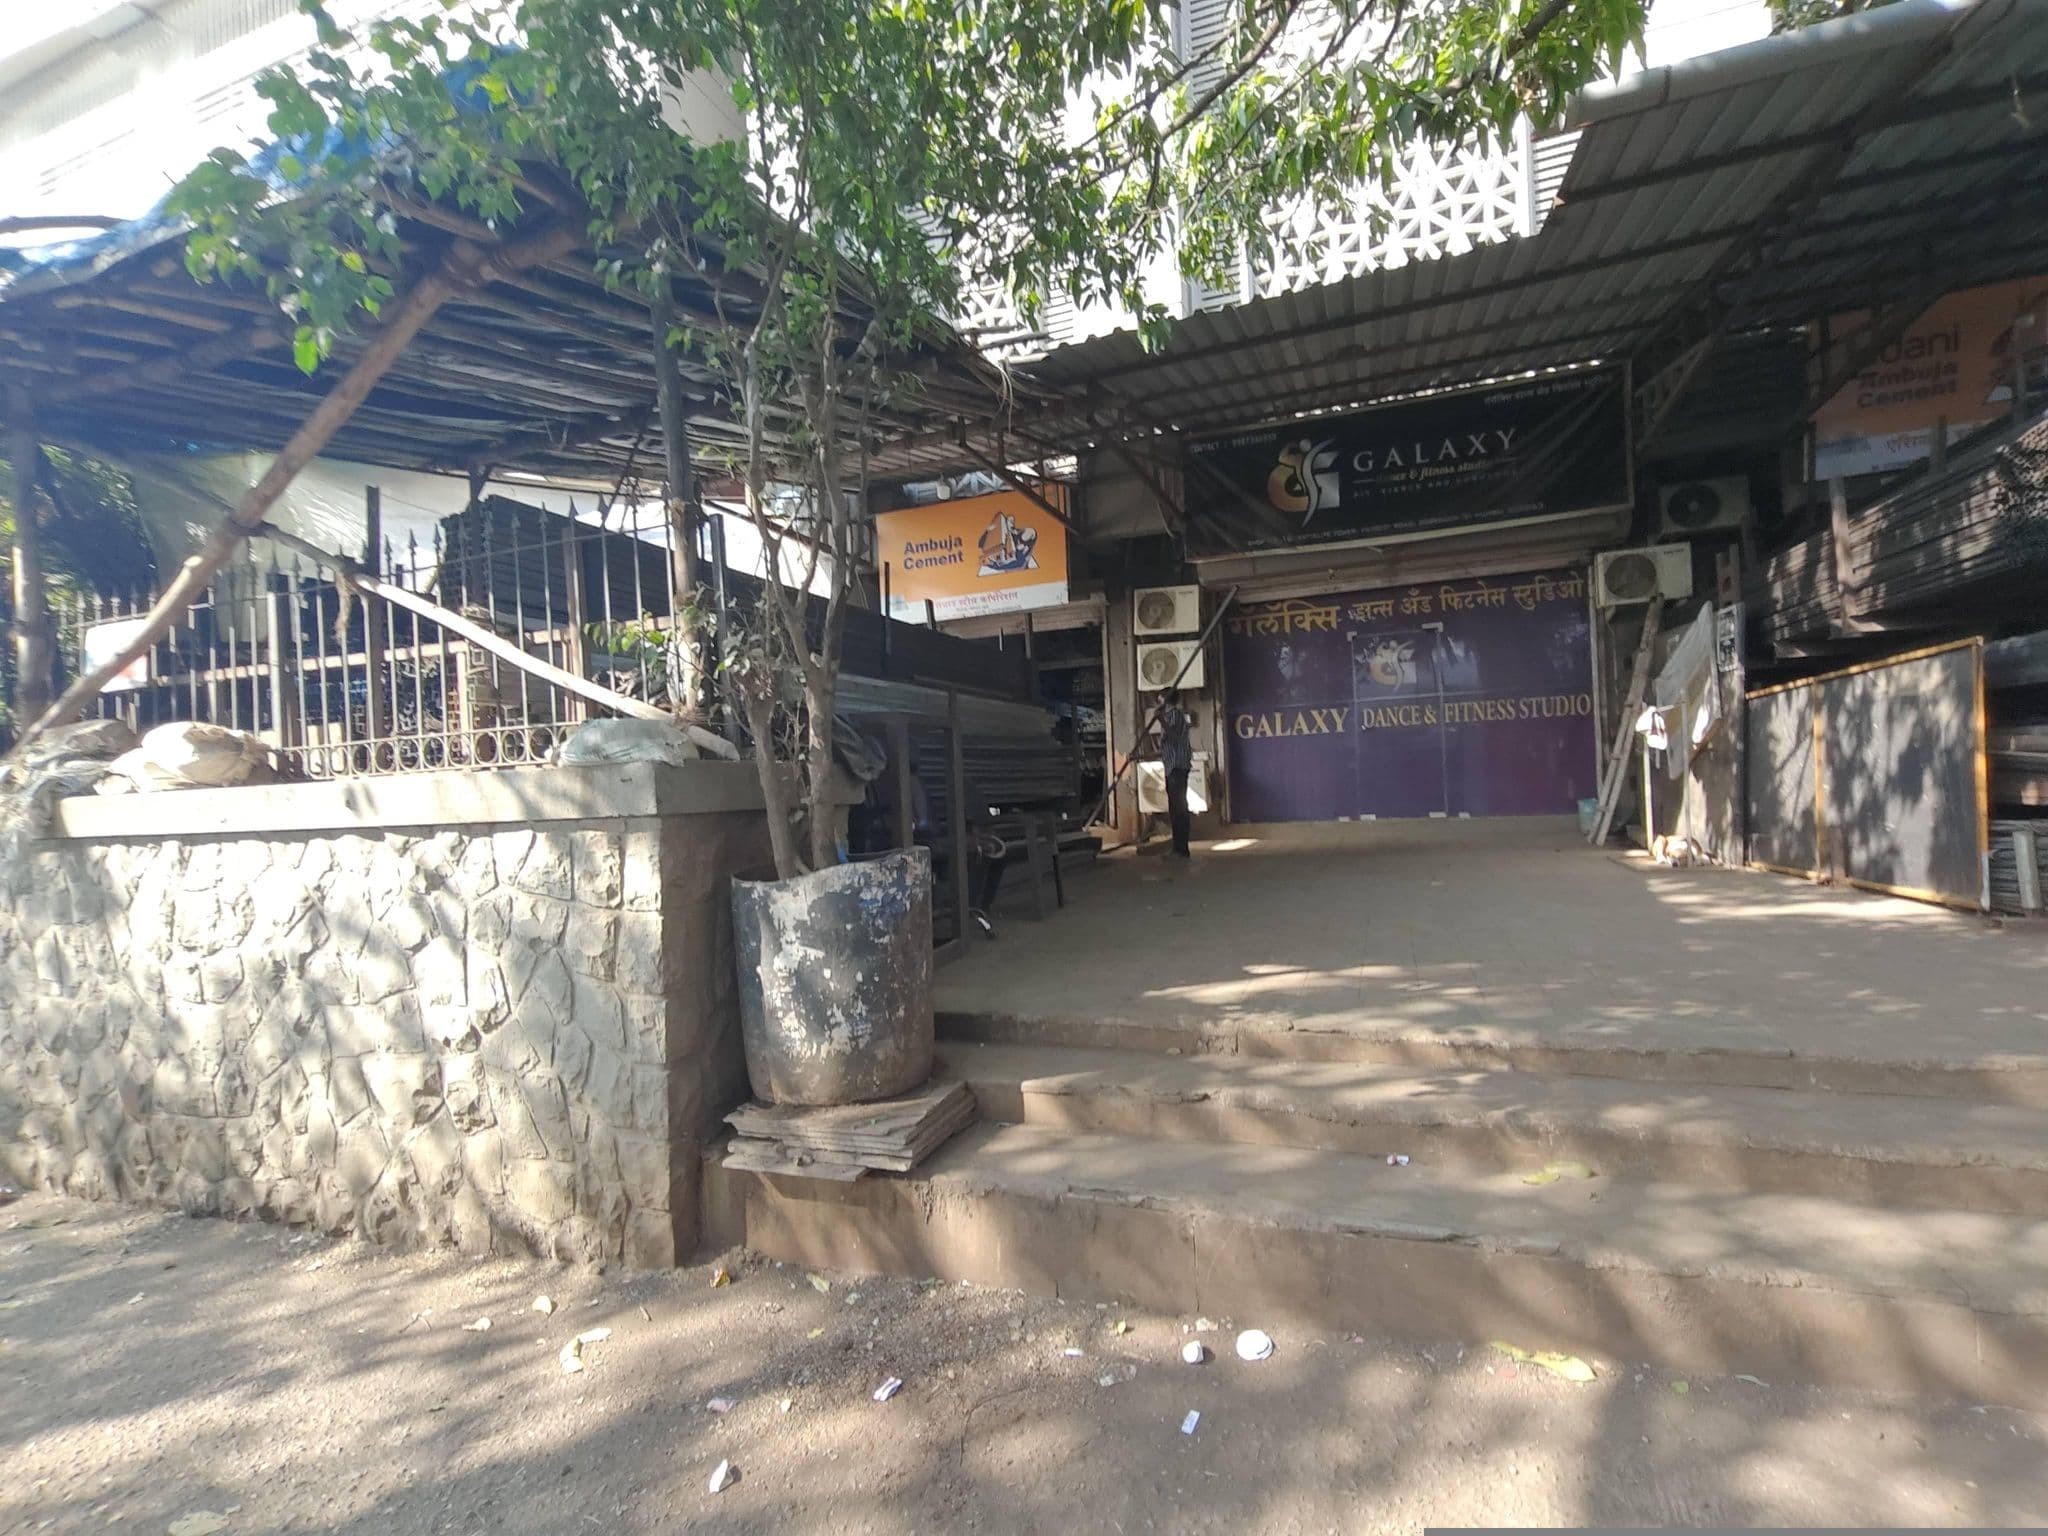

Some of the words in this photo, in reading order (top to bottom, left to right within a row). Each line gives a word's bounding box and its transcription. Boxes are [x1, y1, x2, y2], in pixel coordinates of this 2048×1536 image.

[1856, 378, 1957, 409] Cement
[1352, 428, 1517, 473] GALAXY
[903, 535, 964, 555] Ambuja
[903, 551, 965, 571] Cement
[1439, 580, 1509, 611] फिटनेस
[1234, 707, 1349, 740] GALAXY
[1362, 704, 1421, 728] DANCE
[1423, 703, 1437, 725] &
[1444, 699, 1517, 723] FITNESS
[1519, 693, 1592, 720] STUDIO
